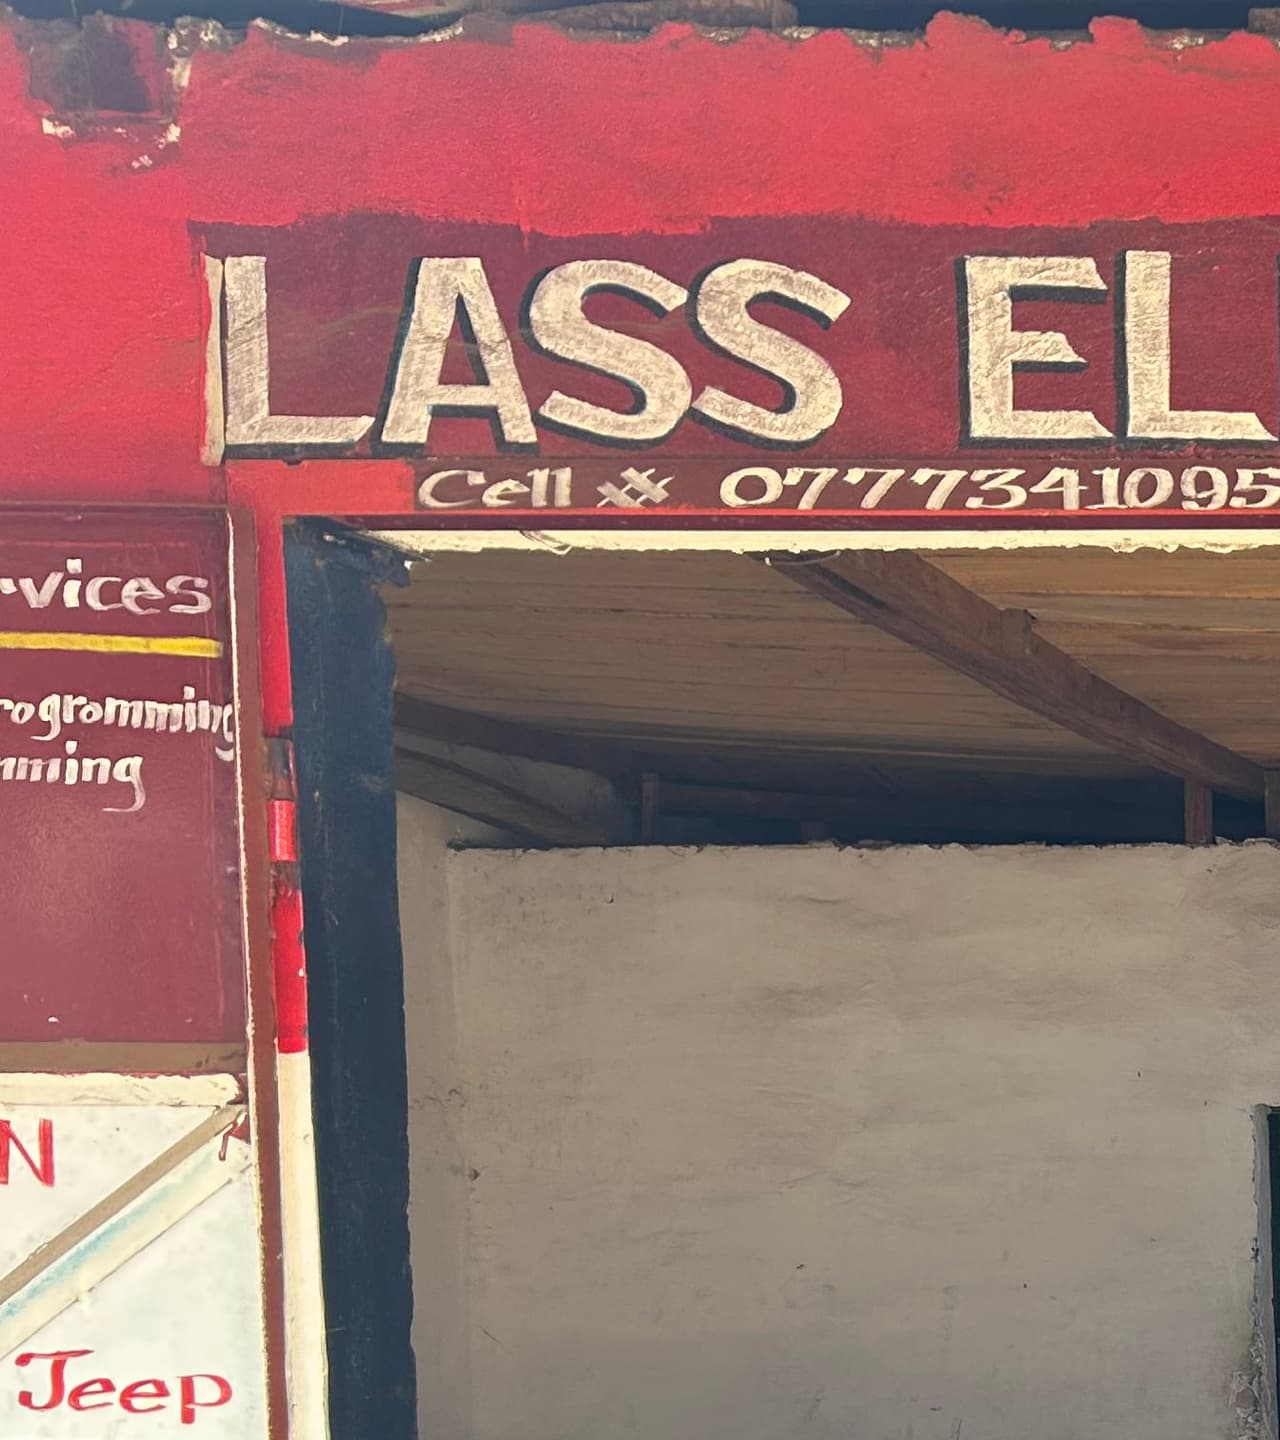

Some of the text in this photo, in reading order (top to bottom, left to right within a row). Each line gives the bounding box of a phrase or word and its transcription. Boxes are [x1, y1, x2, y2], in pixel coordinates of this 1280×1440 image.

[220, 254, 853, 452] LASS
[417, 466, 573, 510] Cell
[15, 1349, 233, 1424] Jeep
